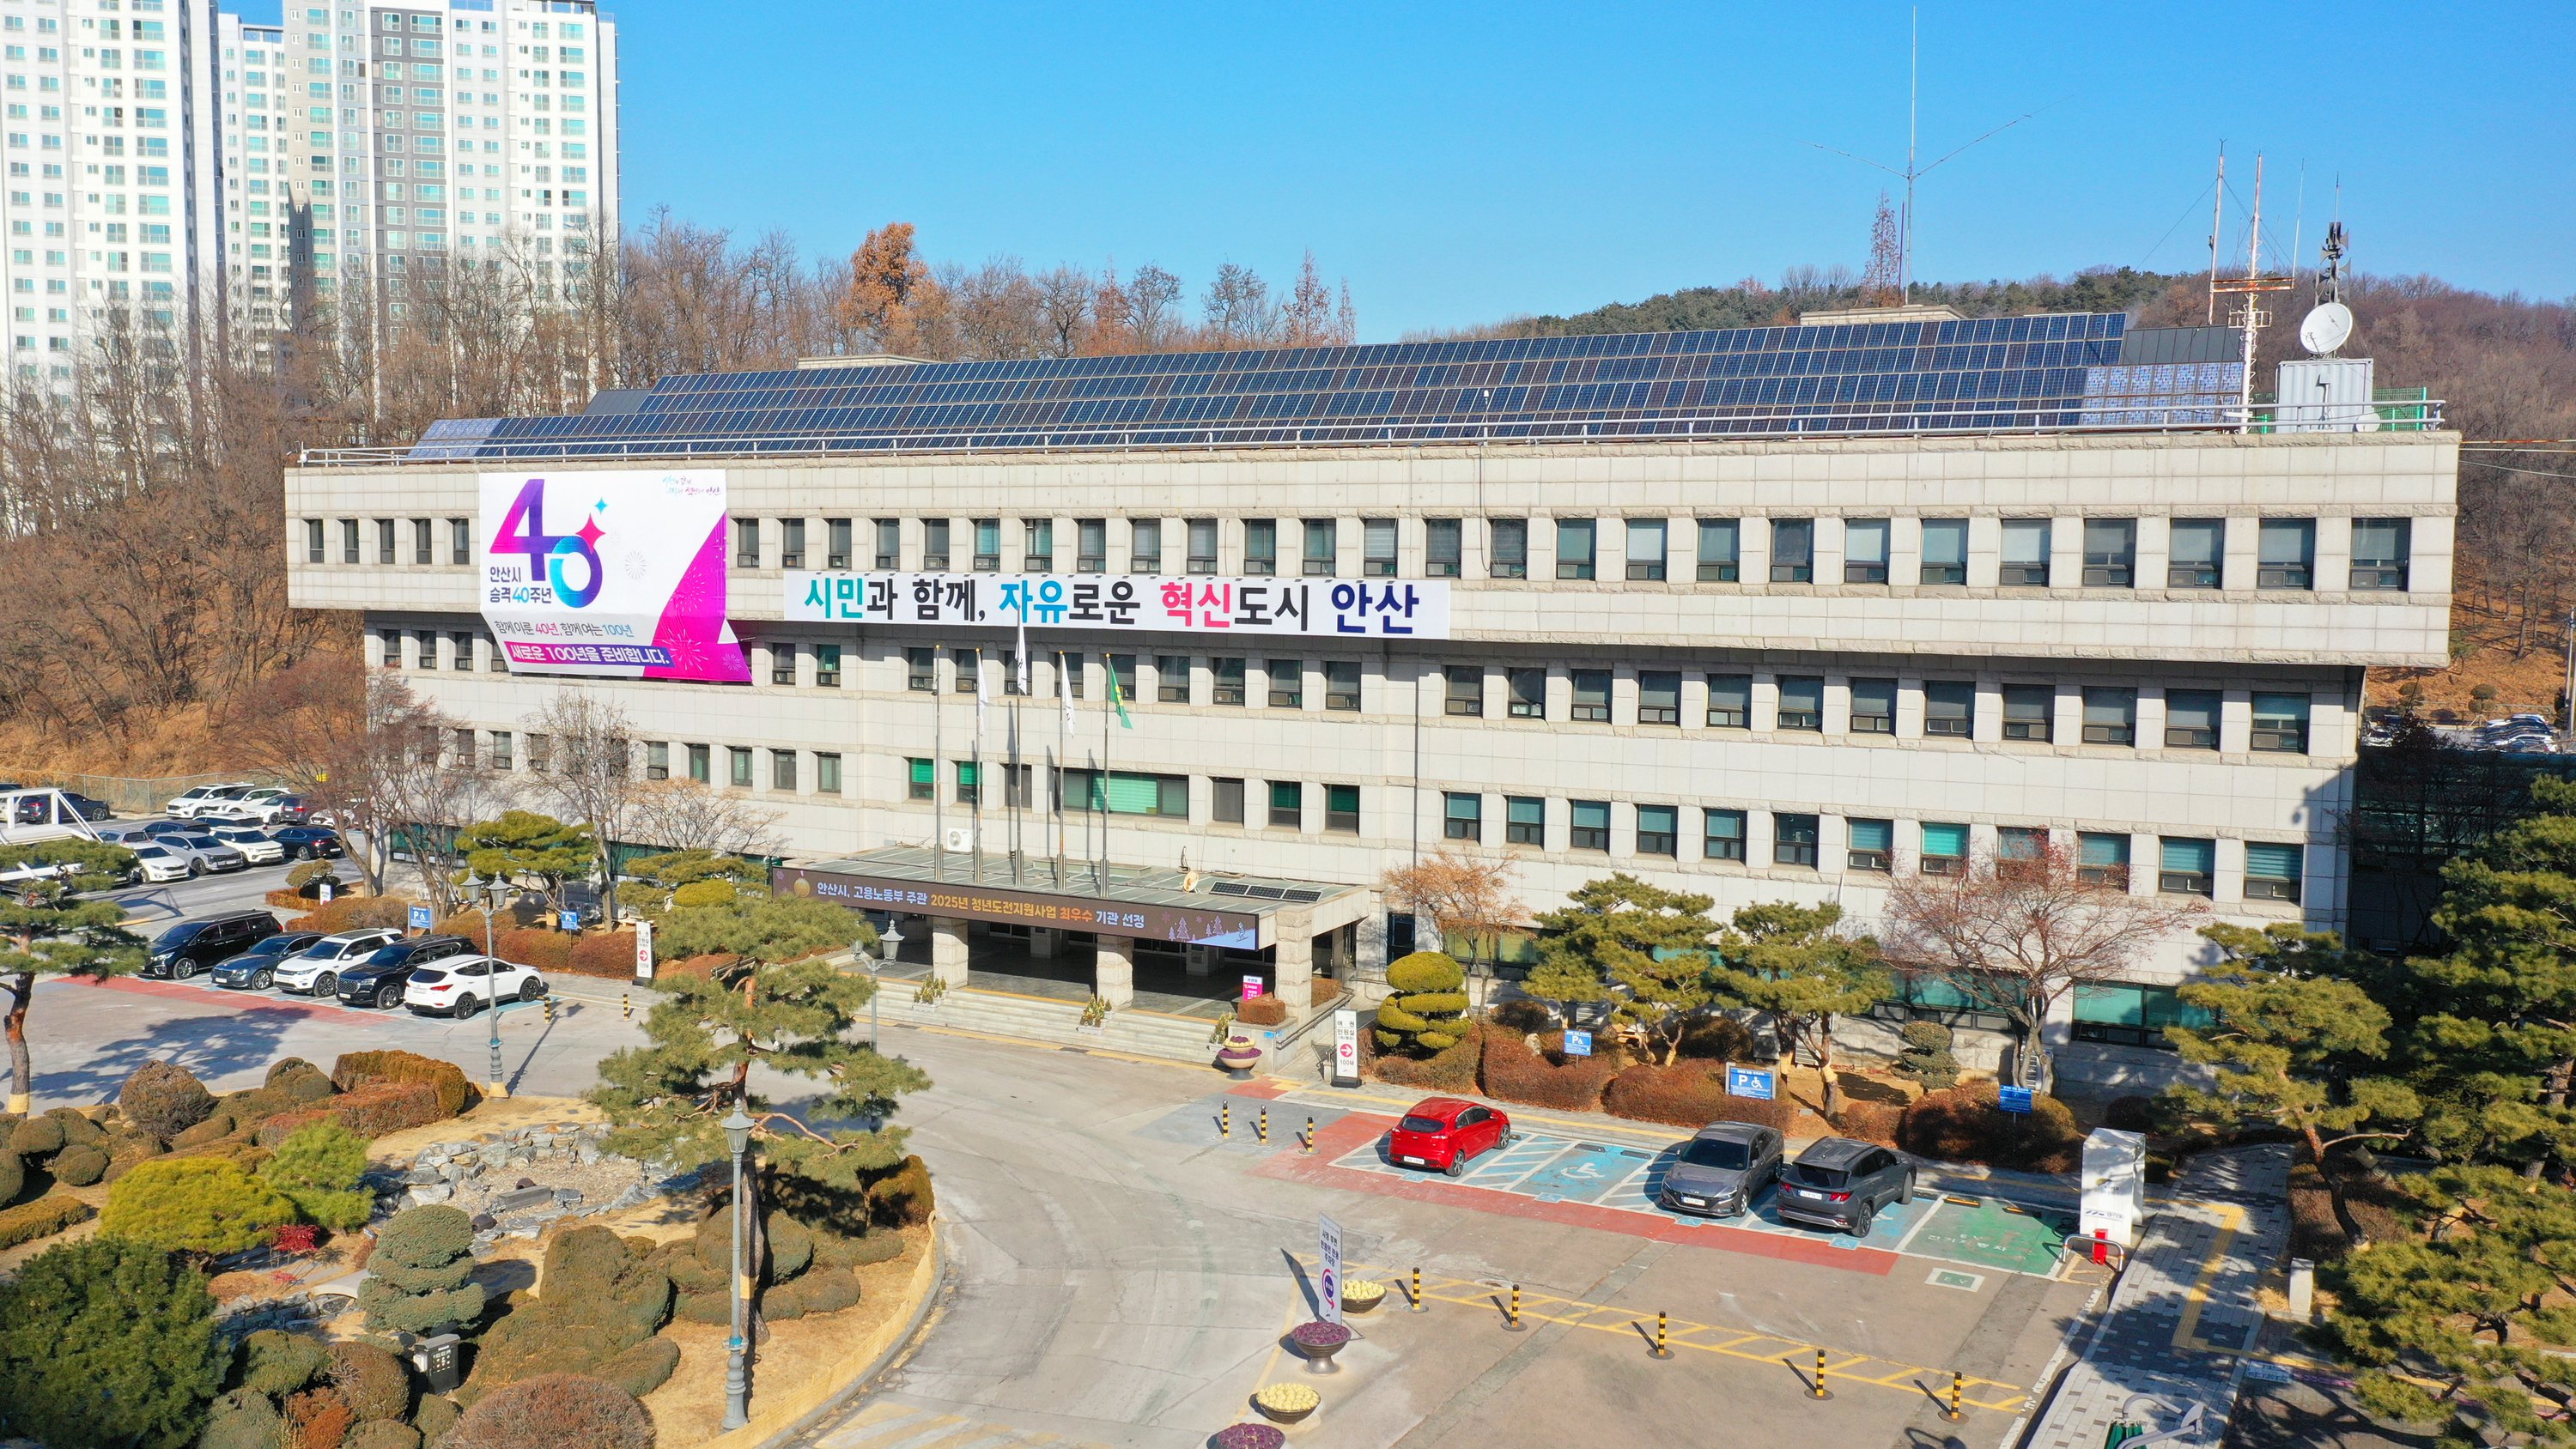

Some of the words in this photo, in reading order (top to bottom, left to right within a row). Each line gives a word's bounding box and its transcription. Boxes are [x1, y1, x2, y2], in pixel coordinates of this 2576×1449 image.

[489, 479, 603, 608] 40
[490, 567, 521, 582] 안산시
[804, 578, 897, 620] 시민과
[913, 579, 985, 621] 함께,
[999, 580, 1140, 624] 자유로운
[1160, 581, 1308, 631] 혁신도시
[1330, 583, 1419, 635] 안산
[510, 645, 546, 661] 새로운
[545, 646, 601, 662] 100년을
[600, 647, 670, 664] 준비합니다.
[817, 882, 849, 898] 안산시,
[854, 886, 903, 902] 고용노동부
[907, 891, 927, 906] 주관
[931, 894, 968, 910] 2025년
[971, 897, 1056, 919] 청년도전지원사업
[1060, 906, 1093, 922] 최우수
[1096, 911, 1119, 924] 기관
[1122, 913, 1145, 928] 선정
[1739, 1074, 1748, 1086] P
